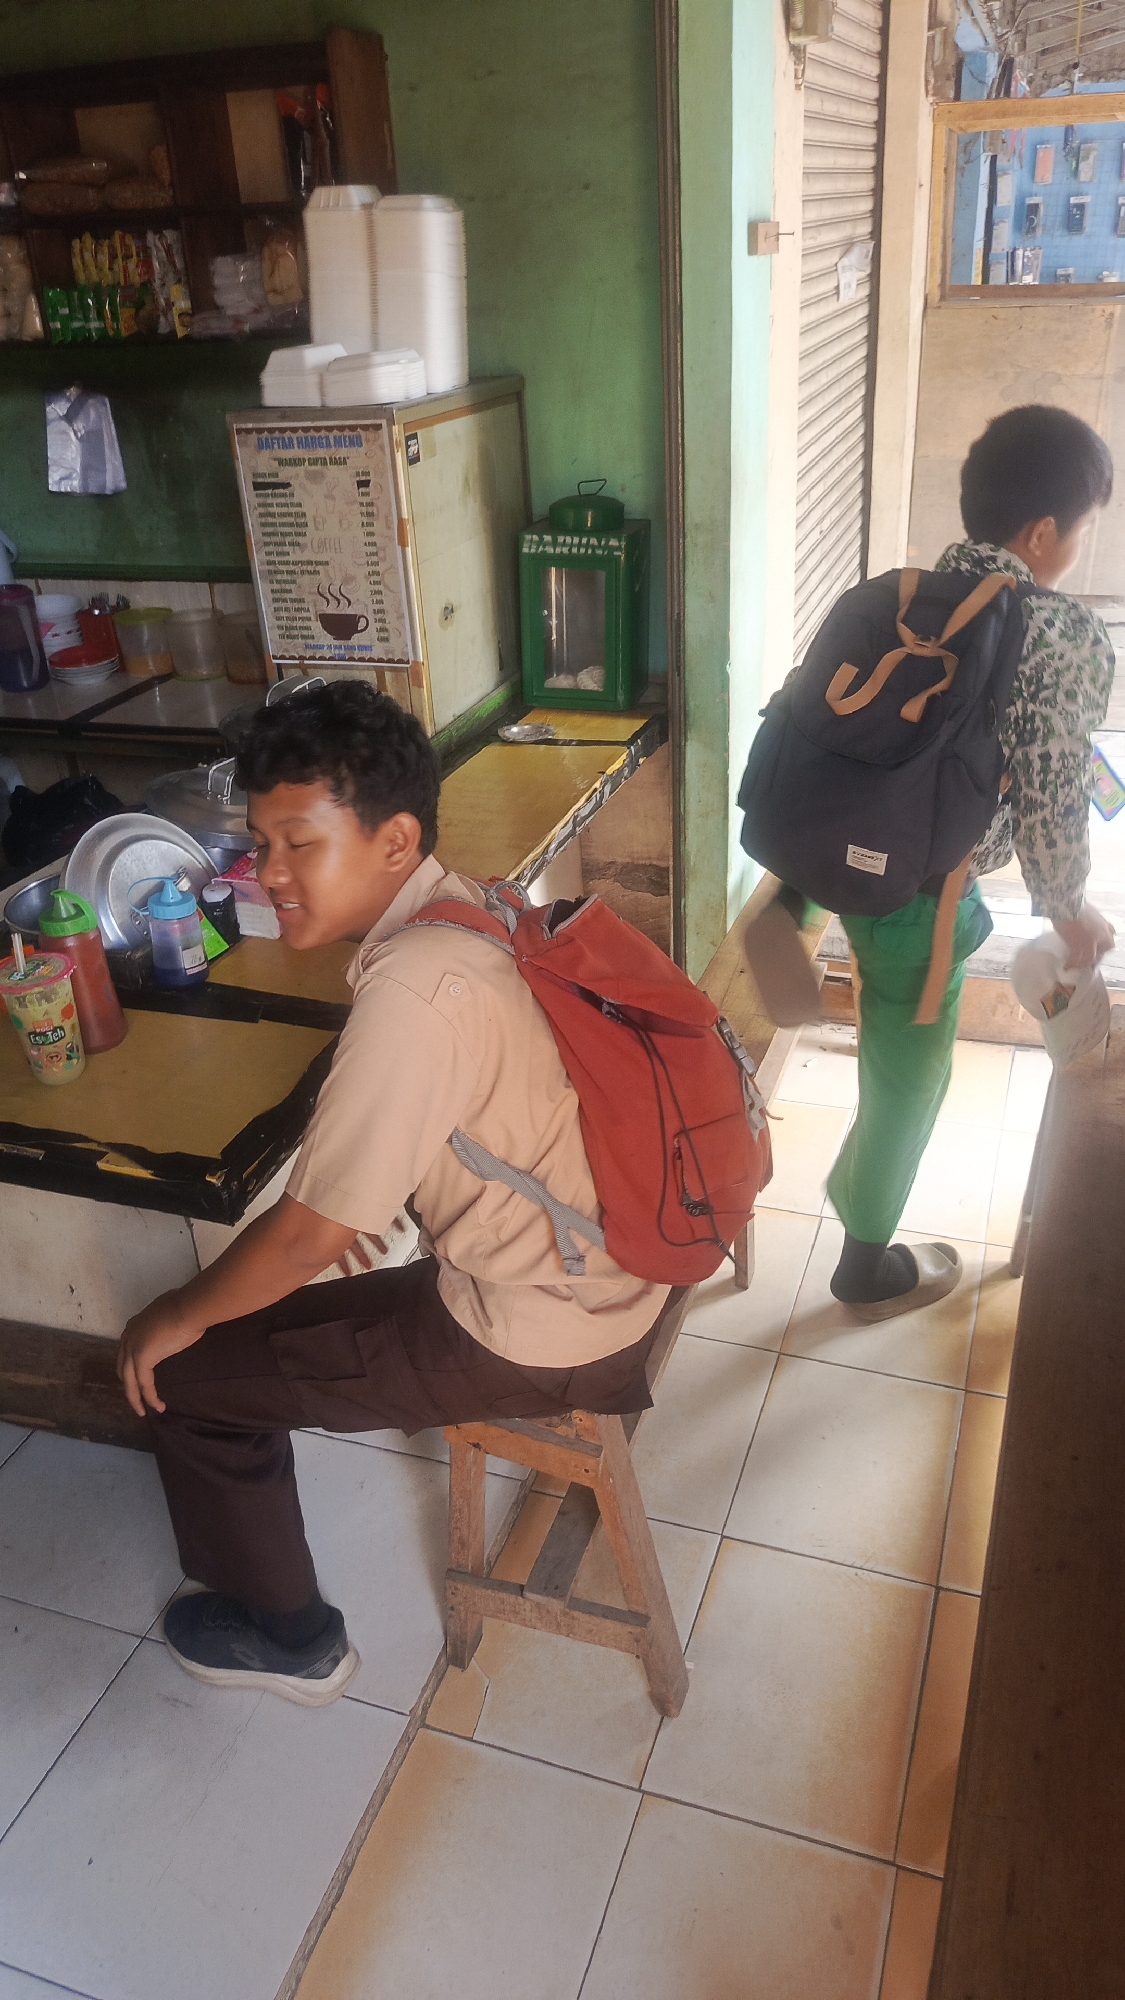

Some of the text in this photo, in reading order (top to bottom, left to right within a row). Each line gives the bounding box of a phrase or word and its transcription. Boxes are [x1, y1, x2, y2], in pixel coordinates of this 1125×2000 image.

[257, 434, 364, 450] DAFTAR HARGA MENU
